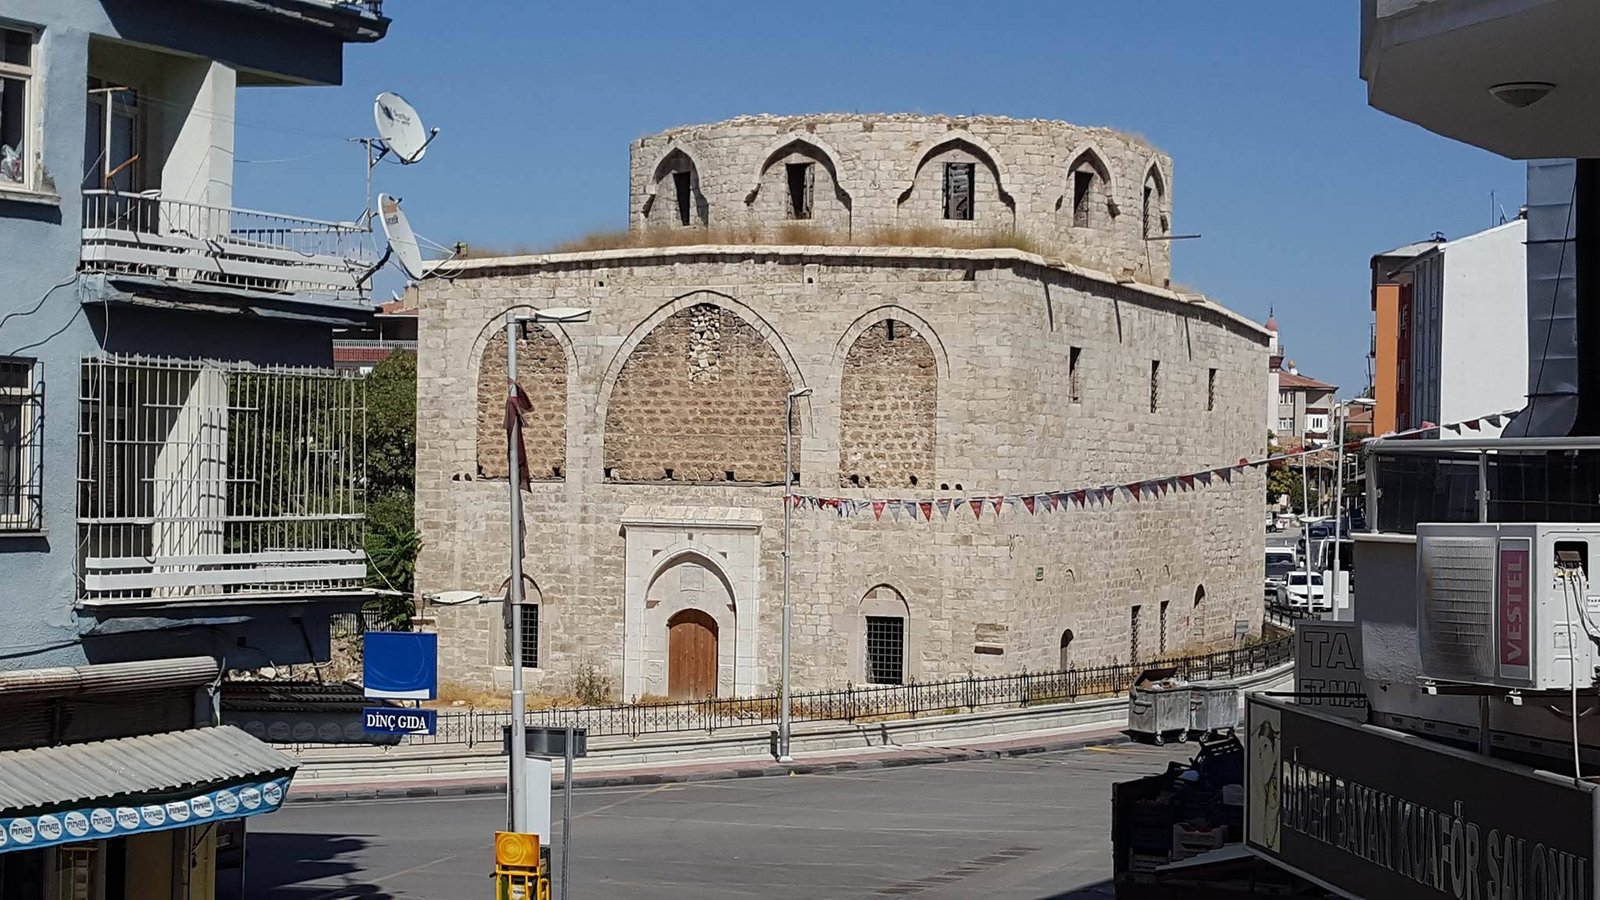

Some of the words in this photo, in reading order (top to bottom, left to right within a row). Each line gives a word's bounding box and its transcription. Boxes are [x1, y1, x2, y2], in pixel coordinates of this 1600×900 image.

[1507, 555, 1523, 661] VESTEL
[1304, 631, 1361, 669] TA
[1300, 679, 1325, 705] ET
[366, 711, 396, 731] DİNÇ
[398, 715, 427, 729] GIDA
[1335, 776, 1395, 872] BAYAN
[1398, 800, 1481, 900] KUAFÖR
